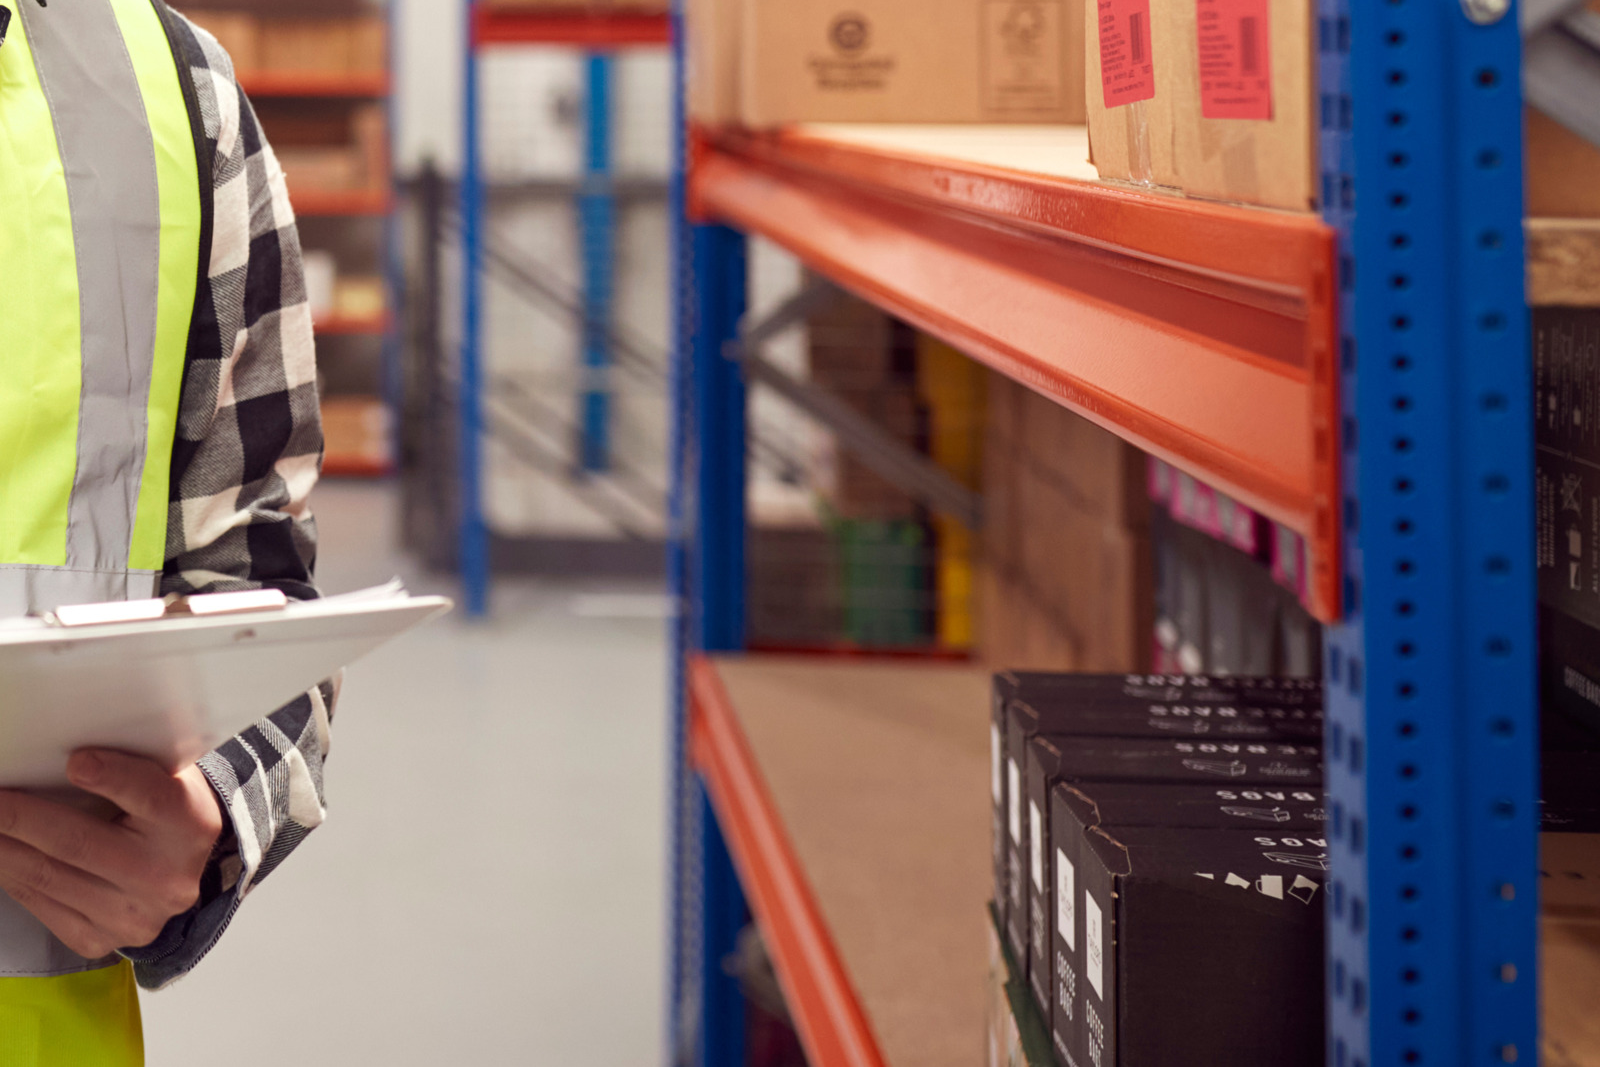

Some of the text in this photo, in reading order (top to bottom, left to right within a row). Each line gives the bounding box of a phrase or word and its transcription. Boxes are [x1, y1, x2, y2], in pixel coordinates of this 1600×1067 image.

[1216, 790, 1317, 801] BAGS
[1254, 837, 1328, 847] AGS
[1057, 950, 1076, 997] COFFEE
[1060, 981, 1073, 1021] BAGS
[1086, 998, 1104, 1049] COFFEE
